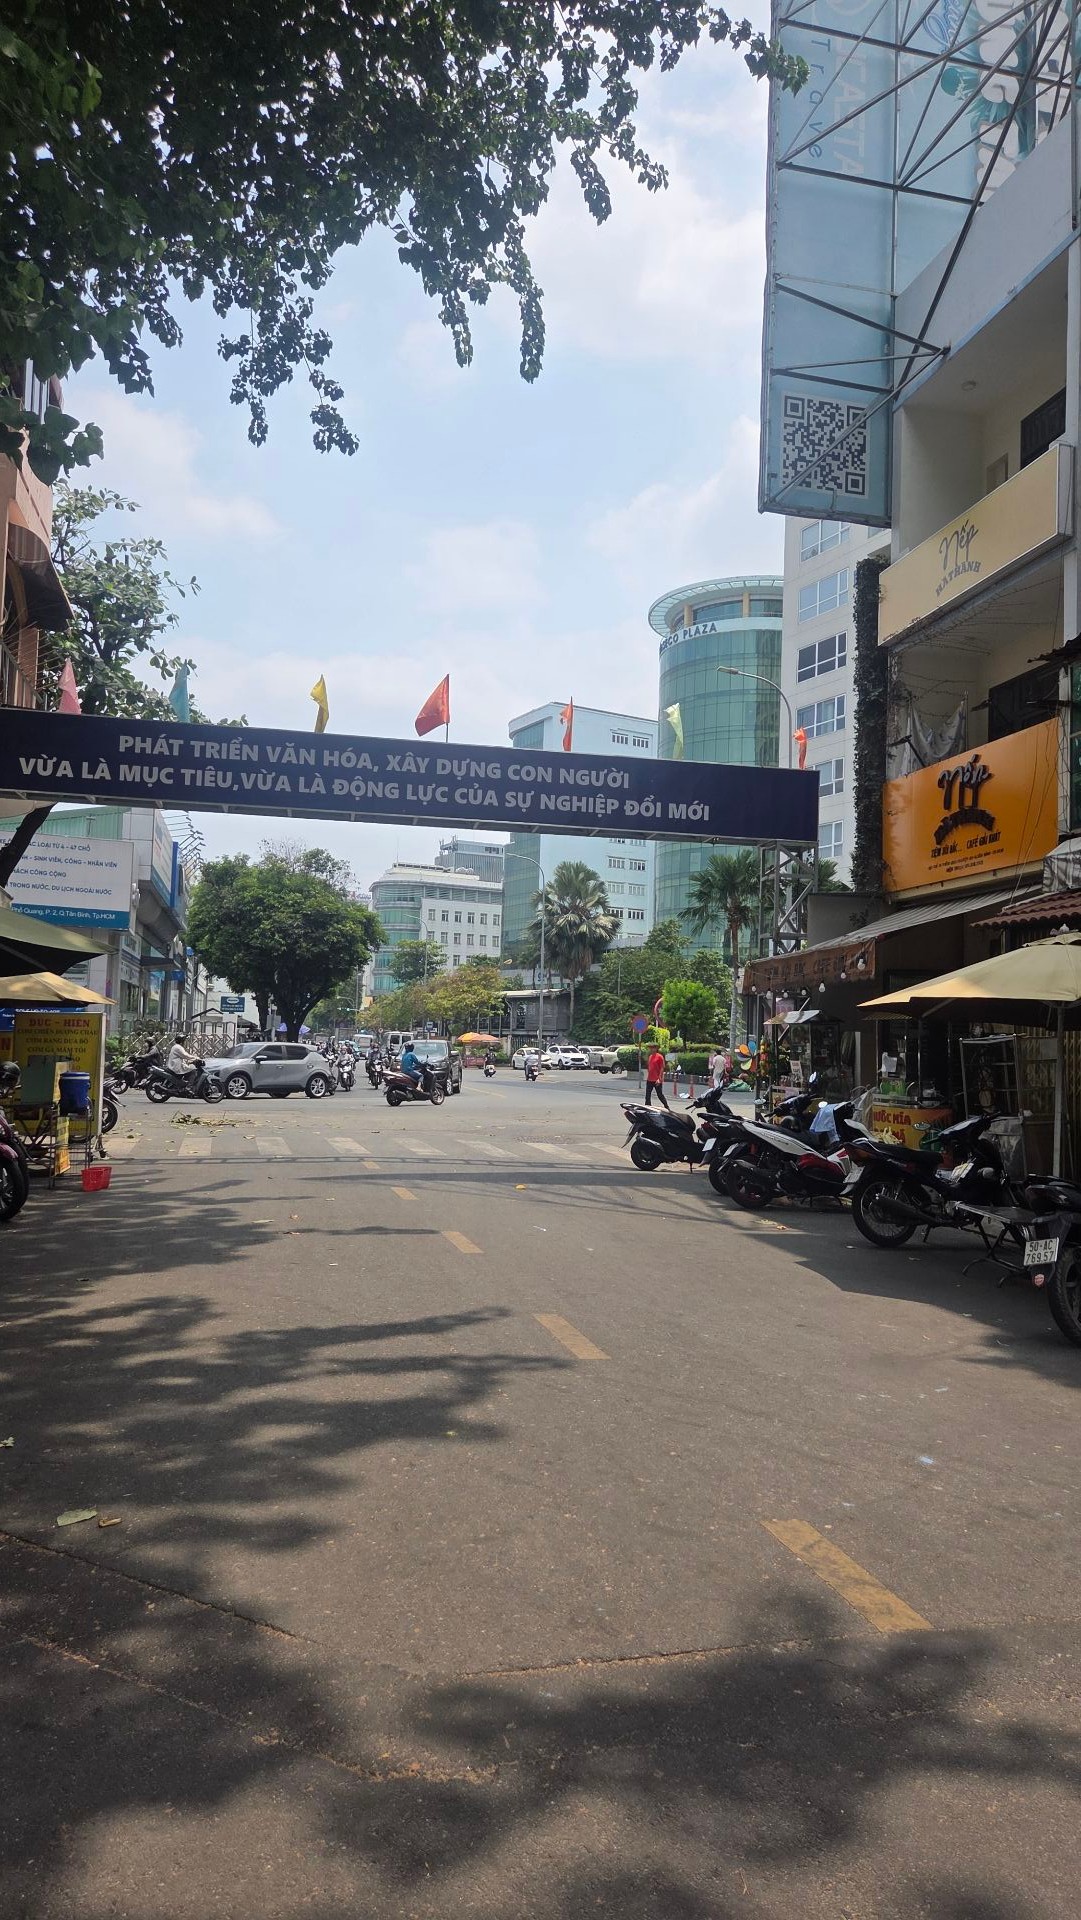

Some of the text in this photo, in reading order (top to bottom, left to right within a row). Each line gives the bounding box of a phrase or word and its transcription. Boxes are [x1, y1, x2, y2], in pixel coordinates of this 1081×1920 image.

[683, 622, 717, 640] PLAZA
[119, 733, 629, 789] PHÁT TRIỂN VĂN HÓA, XÂY DỰNG CON NGƯỜI
[19, 753, 74, 778] VỪA
[81, 757, 111, 781] LÀ
[119, 765, 174, 788] MỤC
[298, 773, 326, 795] LÀ
[332, 776, 400, 801] ĐỘNG
[406, 783, 448, 805] LỰC
[454, 782, 499, 807] CỦA
[504, 790, 534, 813] SỰ
[540, 793, 619, 817] NGHIỆP
[624, 795, 662, 818] ĐỔI
[668, 801, 710, 821] MỚI
[1029, 1240, 1053, 1252] 50-AC
